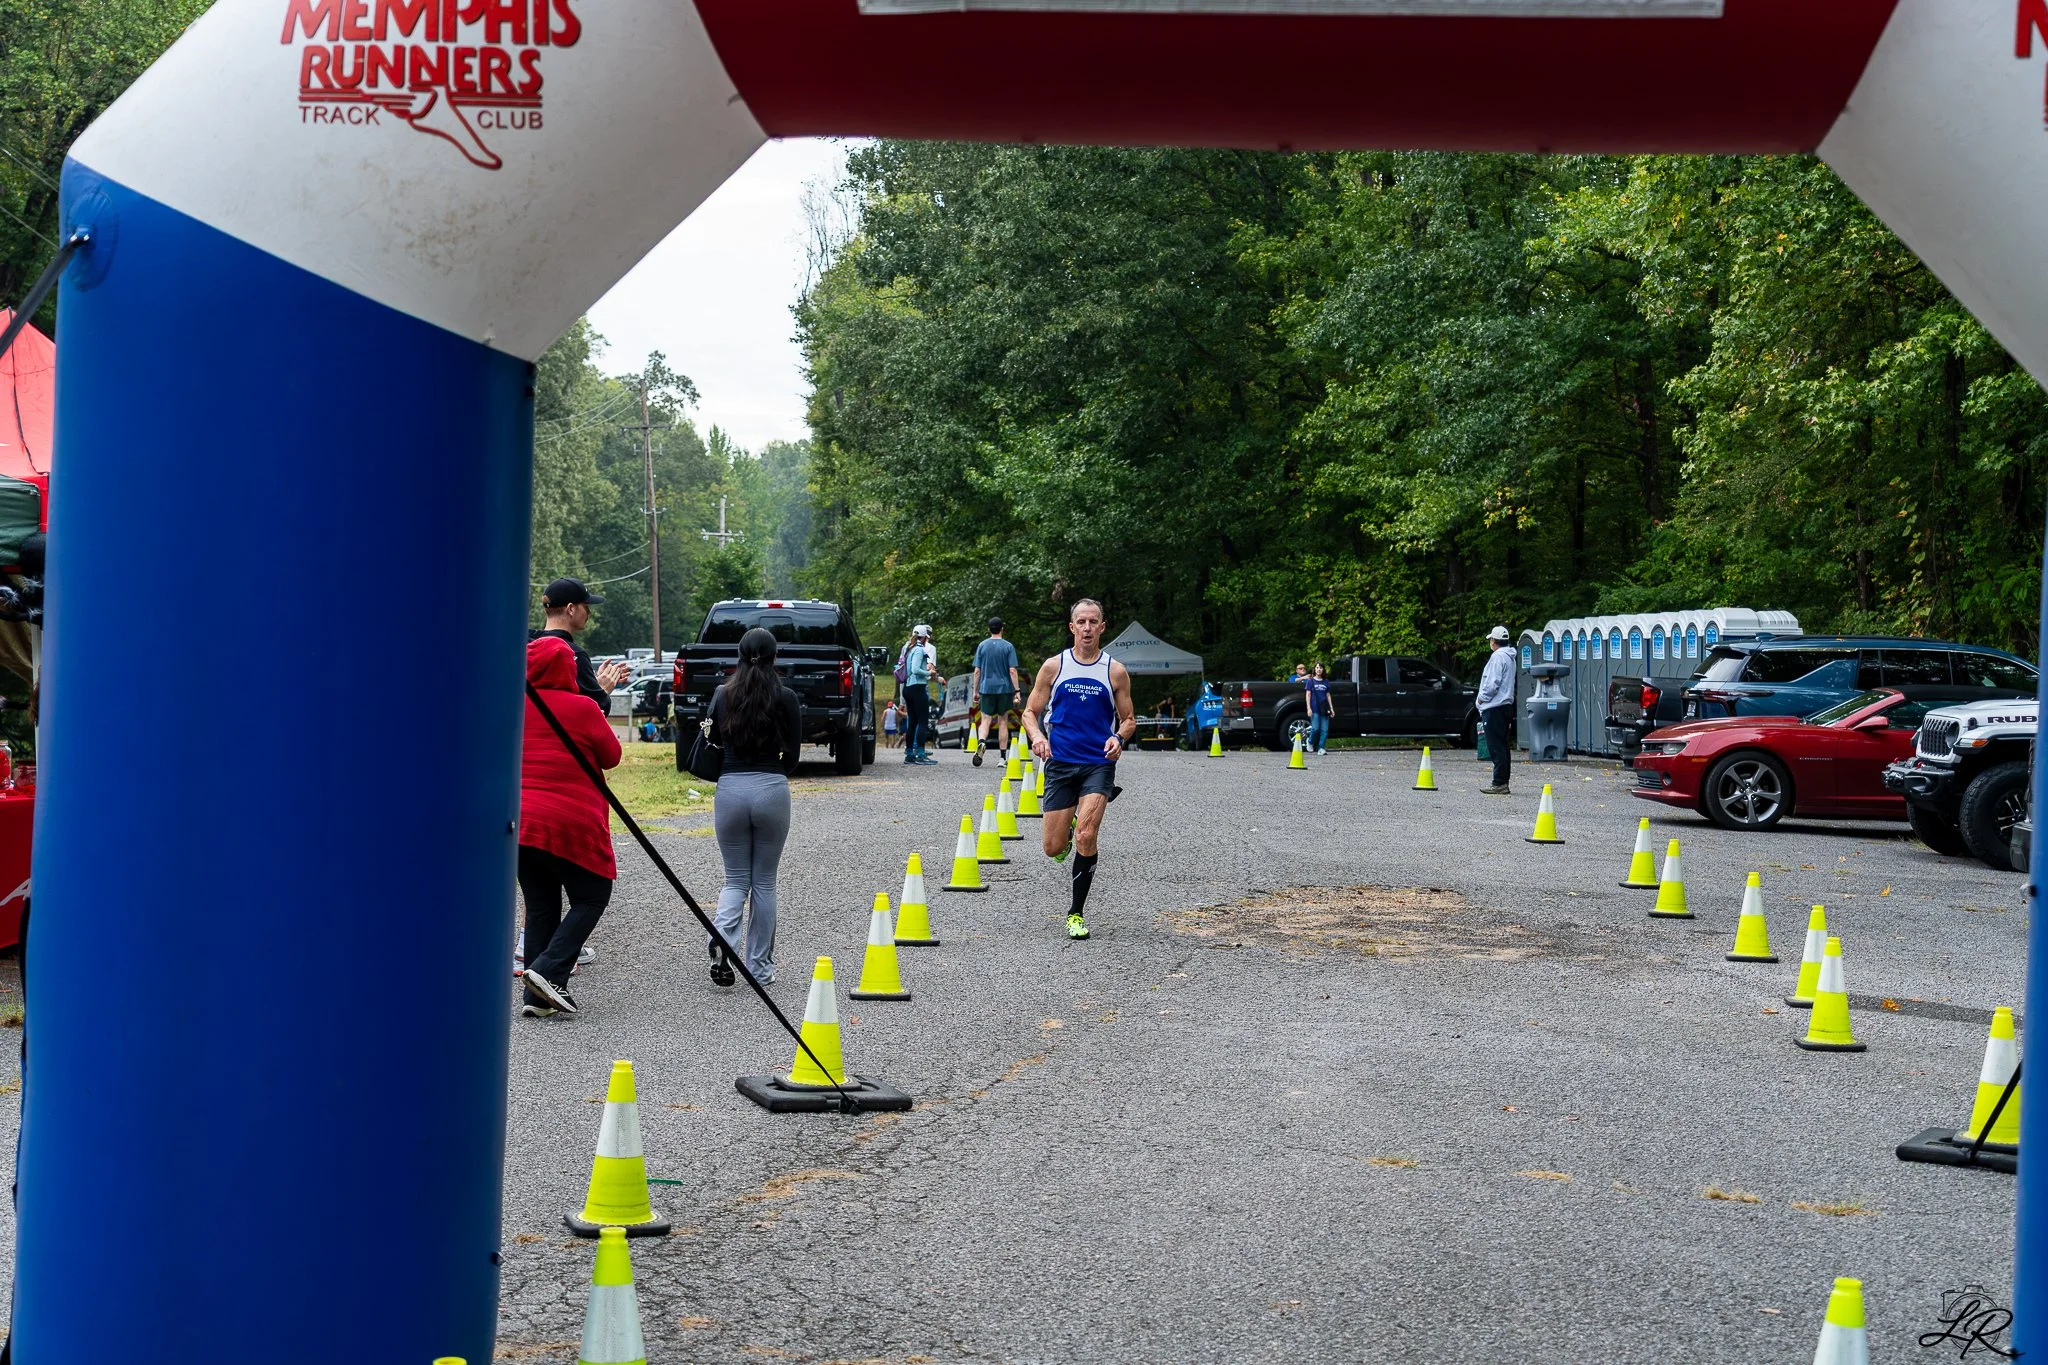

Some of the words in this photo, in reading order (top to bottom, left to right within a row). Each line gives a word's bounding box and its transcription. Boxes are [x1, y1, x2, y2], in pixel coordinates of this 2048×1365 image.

[280, 0, 581, 47] MEMPHIS
[300, 45, 544, 94] RUNNERS
[298, 105, 380, 125] TRACK
[477, 110, 544, 129] CLUB
[1064, 683, 1103, 692] PILGRIMAGE
